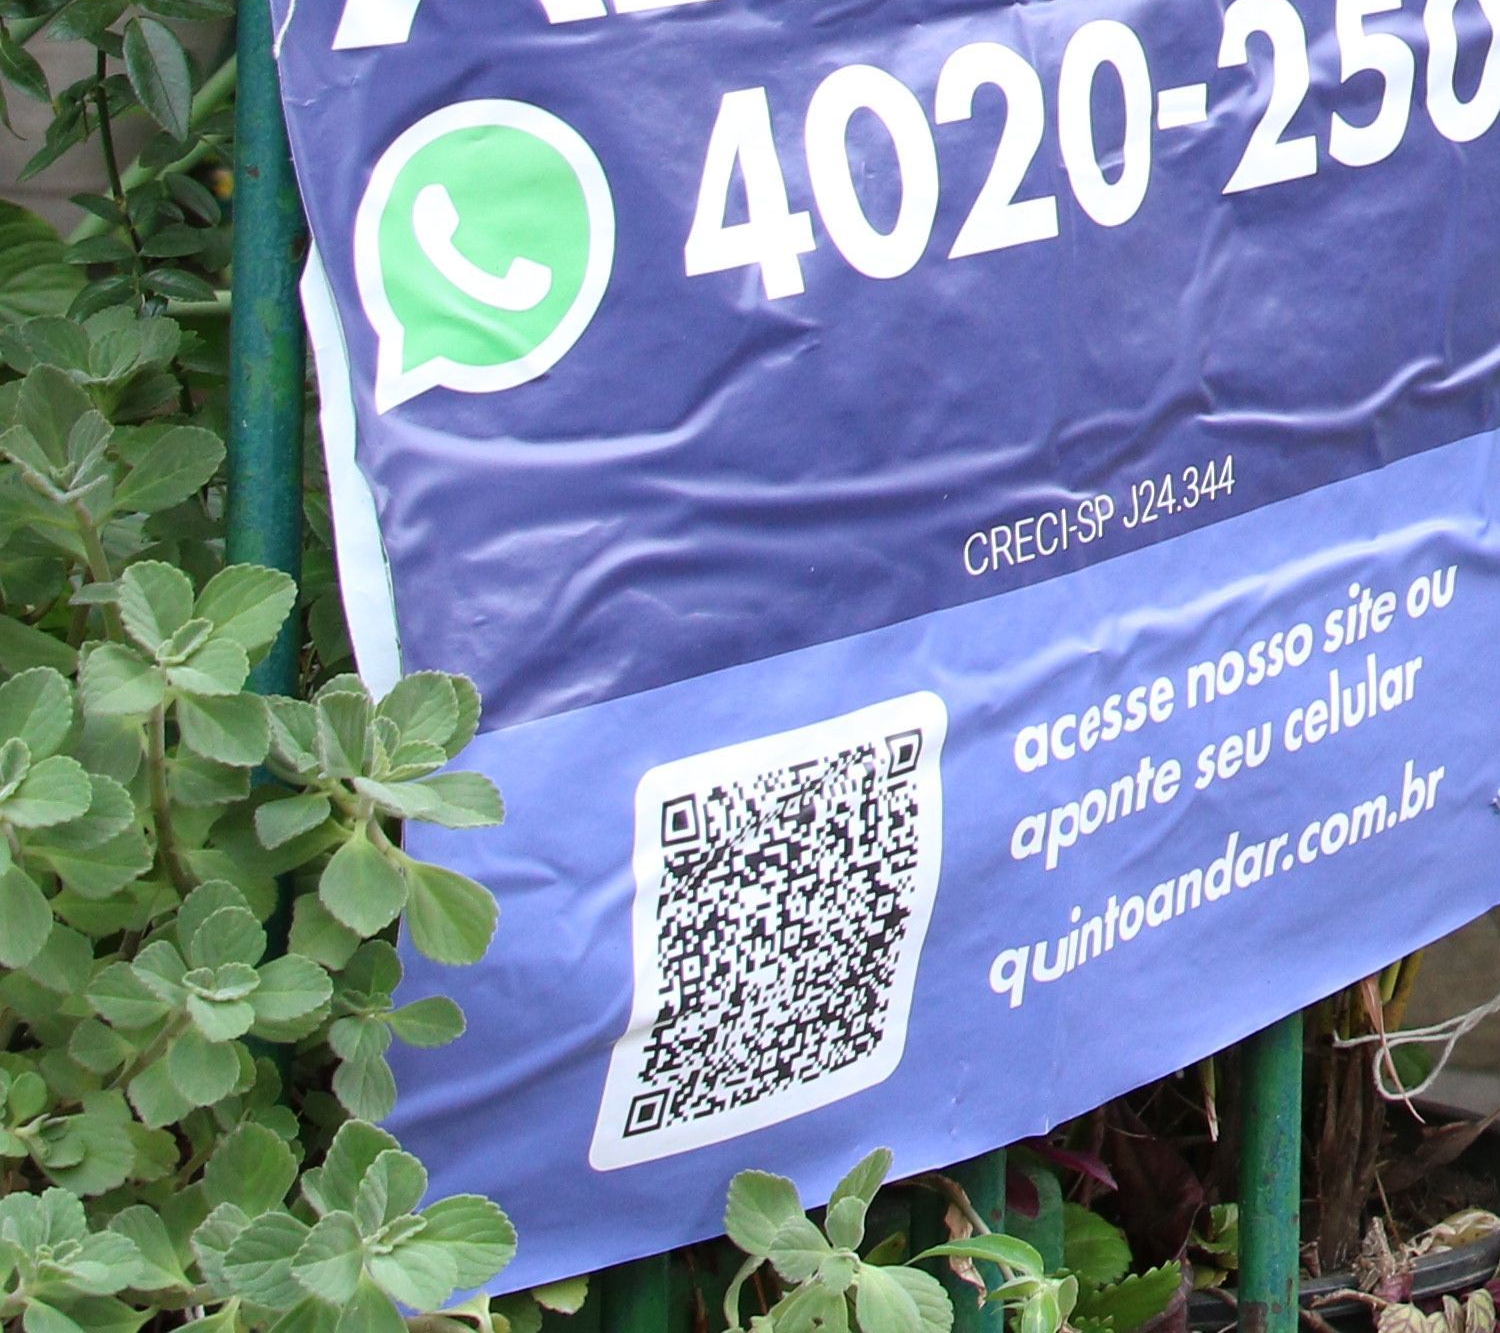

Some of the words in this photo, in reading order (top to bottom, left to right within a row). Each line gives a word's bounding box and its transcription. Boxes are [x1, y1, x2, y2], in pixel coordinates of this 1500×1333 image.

[963, 496, 1116, 577] CRECI-SP
[1122, 454, 1236, 531] J24.344
[1010, 753, 1180, 870] aponte
[1194, 724, 1271, 788] seu
[1283, 651, 1424, 746] celular
[1013, 677, 1174, 771] acesse
[1186, 619, 1313, 711] nosso
[1324, 581, 1396, 650] site
[1407, 564, 1457, 618] ou
[988, 761, 1446, 1009] quintoandar.com.br
